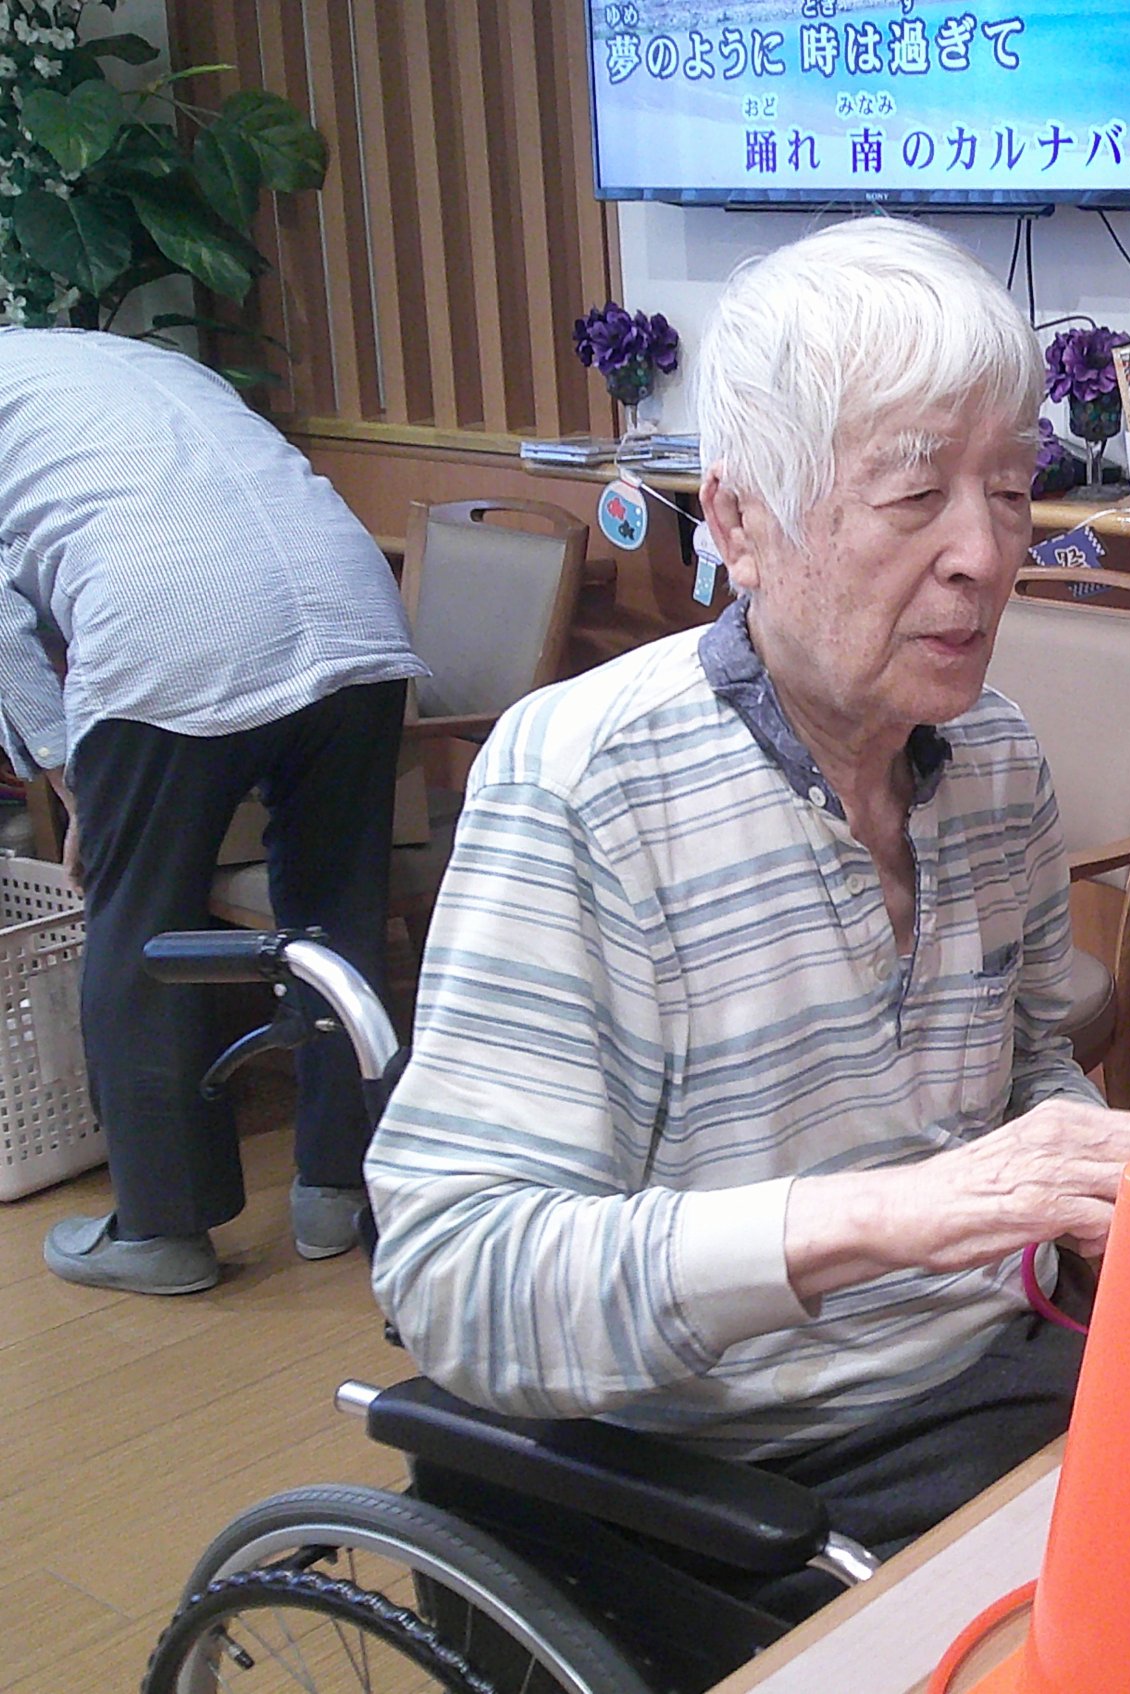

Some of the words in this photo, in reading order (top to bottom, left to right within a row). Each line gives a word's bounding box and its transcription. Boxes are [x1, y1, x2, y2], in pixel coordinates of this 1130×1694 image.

[605, 4, 639, 28] ゆめ
[606, 27, 785, 84] 夢のように
[800, 13, 1025, 78] 時は過ぎて
[744, 96, 776, 117] おど
[838, 95, 894, 116] みなみ
[745, 128, 821, 174] 踊れ
